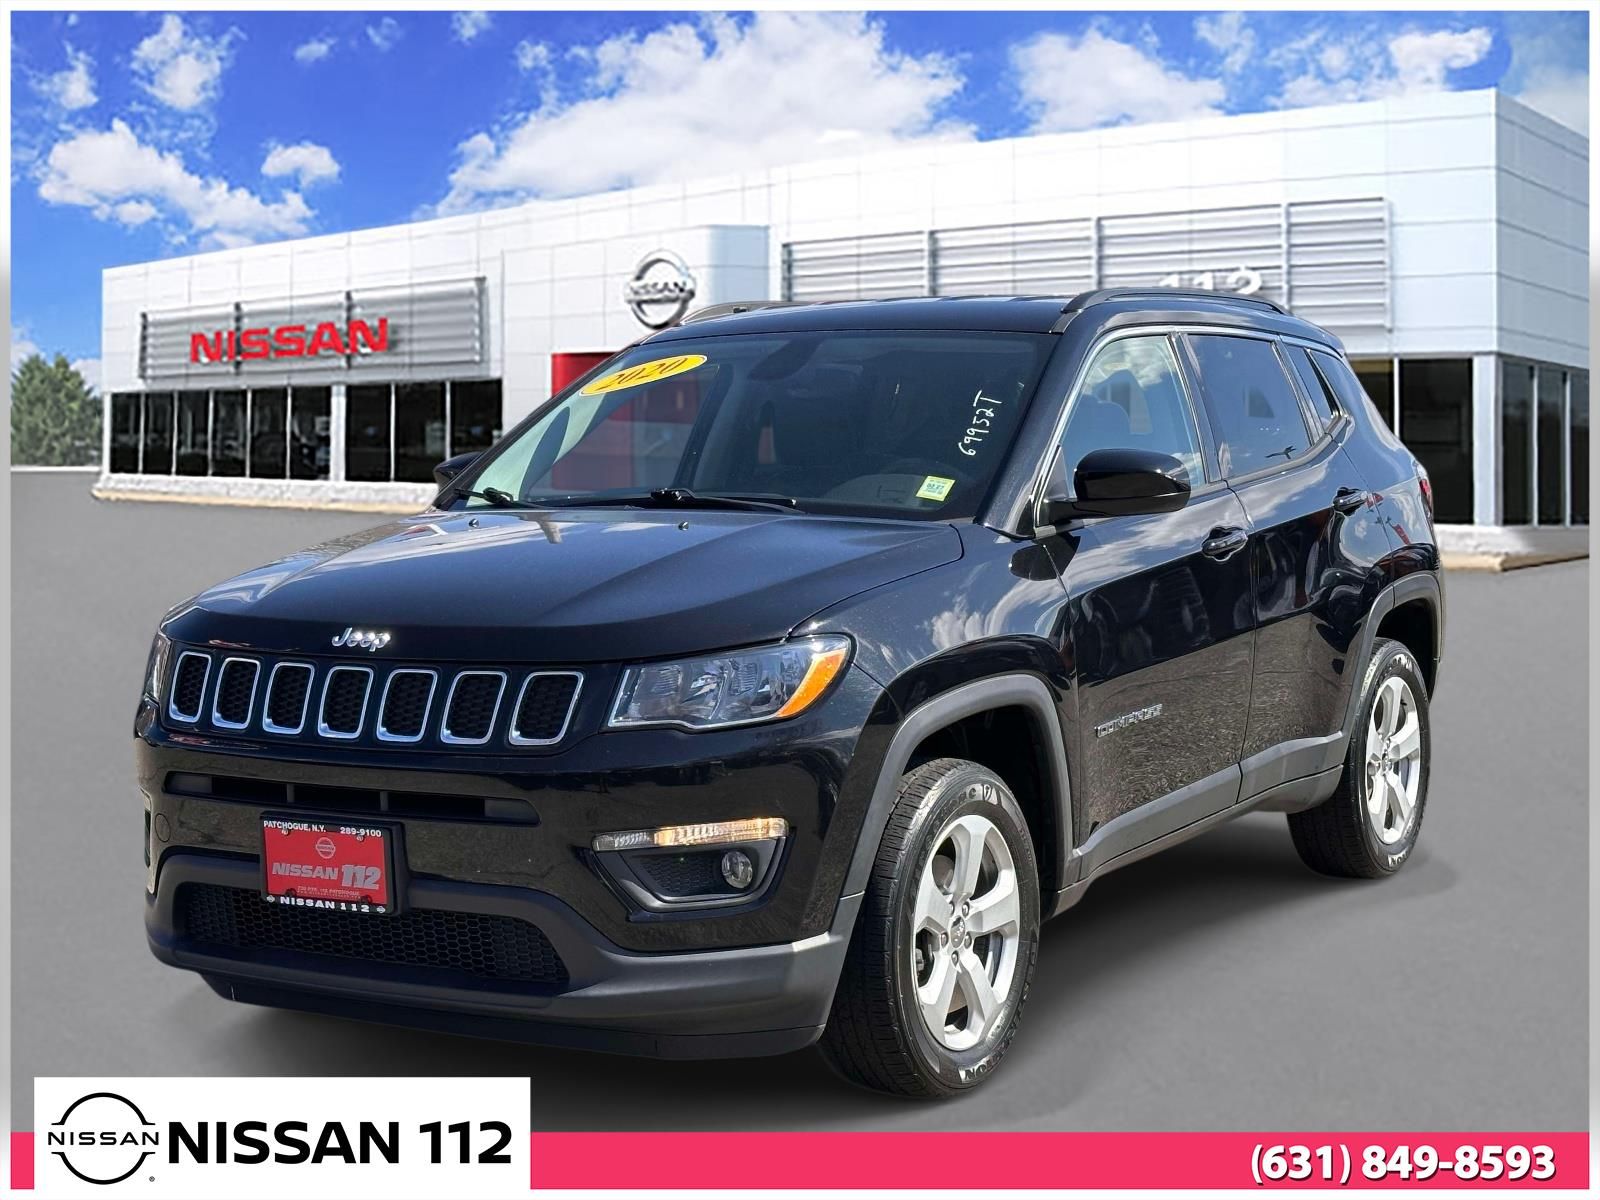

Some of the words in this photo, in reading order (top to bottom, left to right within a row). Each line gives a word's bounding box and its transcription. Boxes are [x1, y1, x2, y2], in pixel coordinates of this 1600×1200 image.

[190, 317, 388, 363] NISSAN
[595, 358, 688, 391] 2020
[958, 390, 1002, 456] 69952T
[332, 627, 391, 652] Jeep
[312, 825, 326, 833] N.Y.
[340, 826, 382, 837] 289-9100
[272, 862, 339, 880] NISSAN
[341, 864, 382, 890] 112
[280, 896, 335, 909] NISSAN
[340, 903, 370, 912] 112
